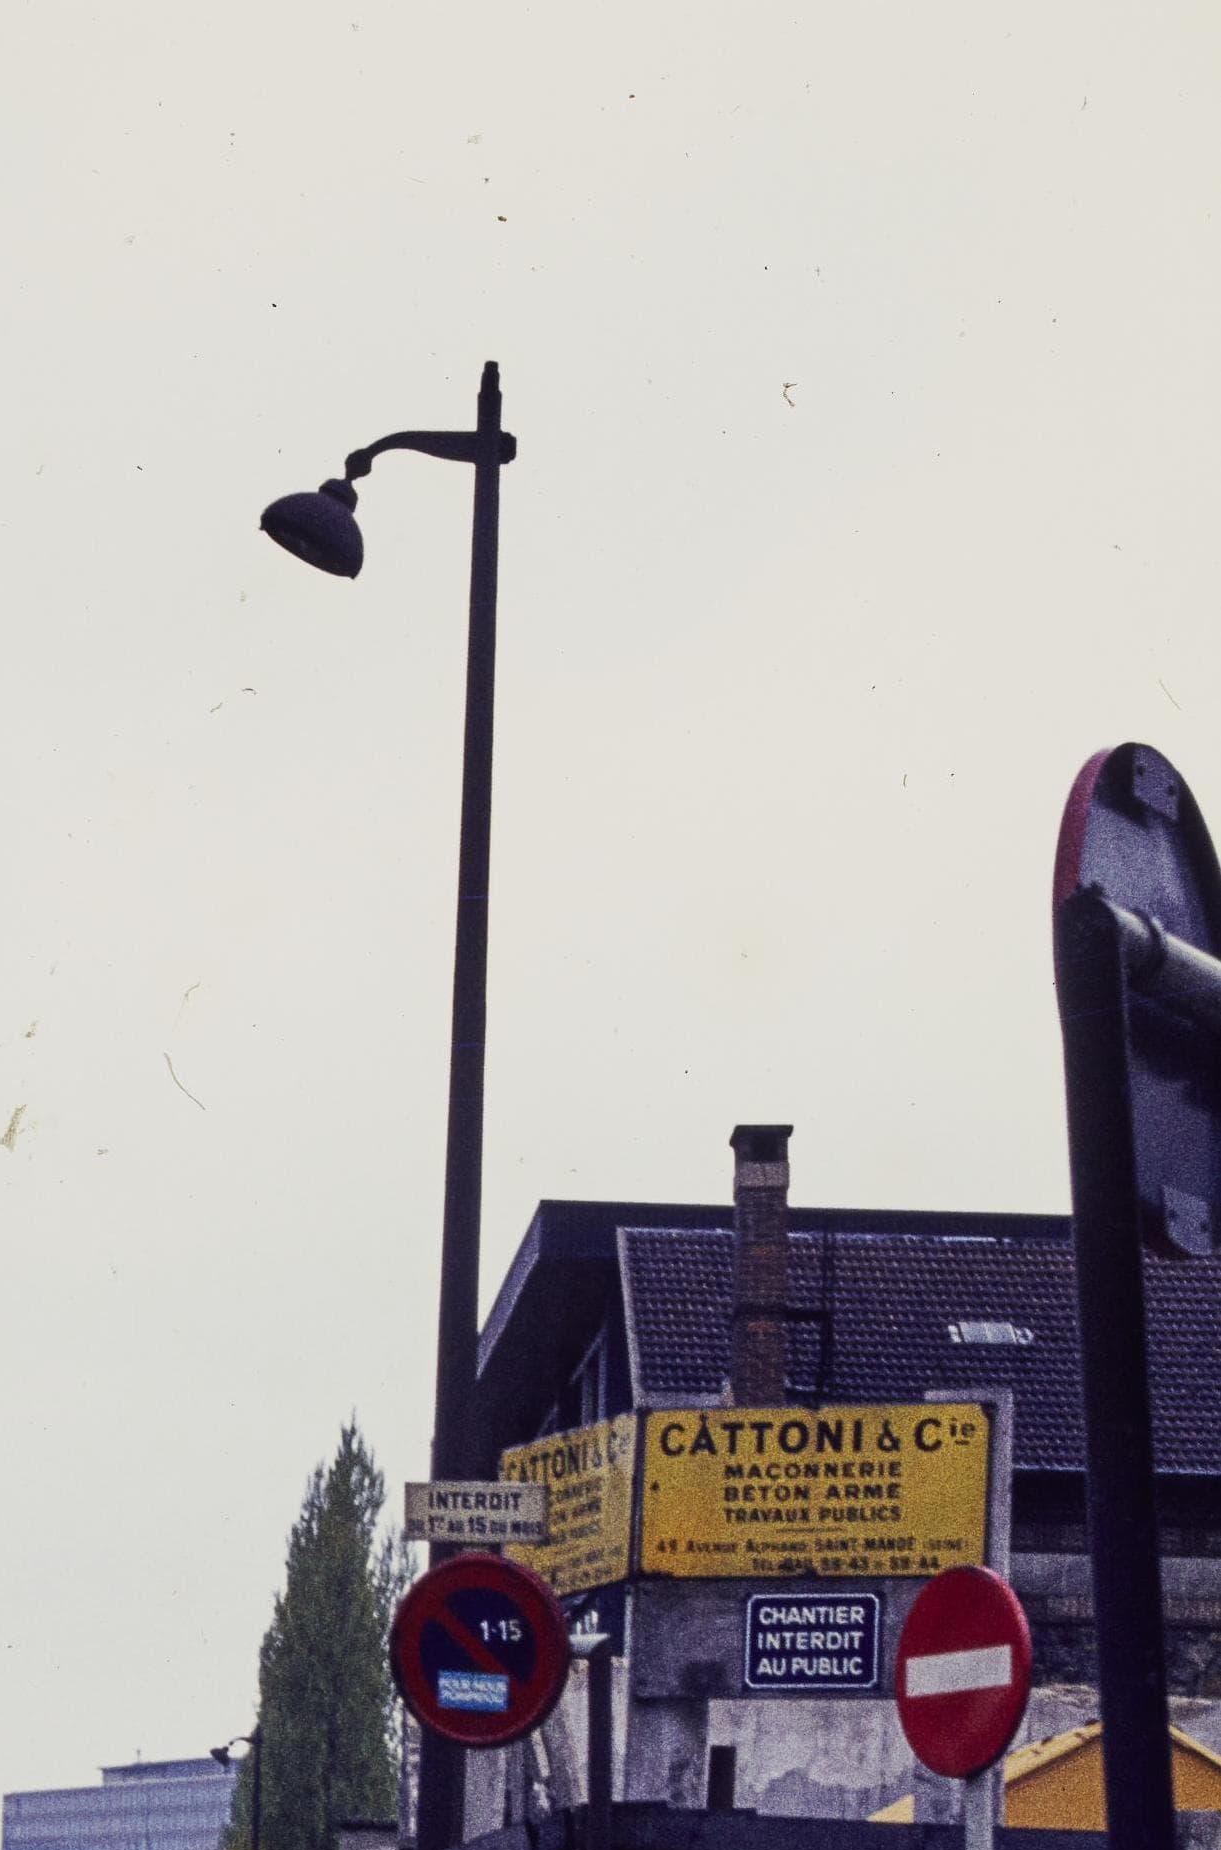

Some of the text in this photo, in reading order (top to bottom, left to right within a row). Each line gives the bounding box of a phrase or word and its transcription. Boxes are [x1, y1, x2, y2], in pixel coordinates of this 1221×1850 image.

[660, 1418, 863, 1456] CATTONI
[877, 1420, 901, 1453] &
[429, 1491, 523, 1511] INTERDIT
[468, 1515, 487, 1534] 15
[723, 1504, 902, 1525] TRAVAUX PUBLICS
[758, 1605, 866, 1625] CHANTIER
[757, 1631, 864, 1651] INTERDIT
[757, 1656, 864, 1676] AU PUBLIC
